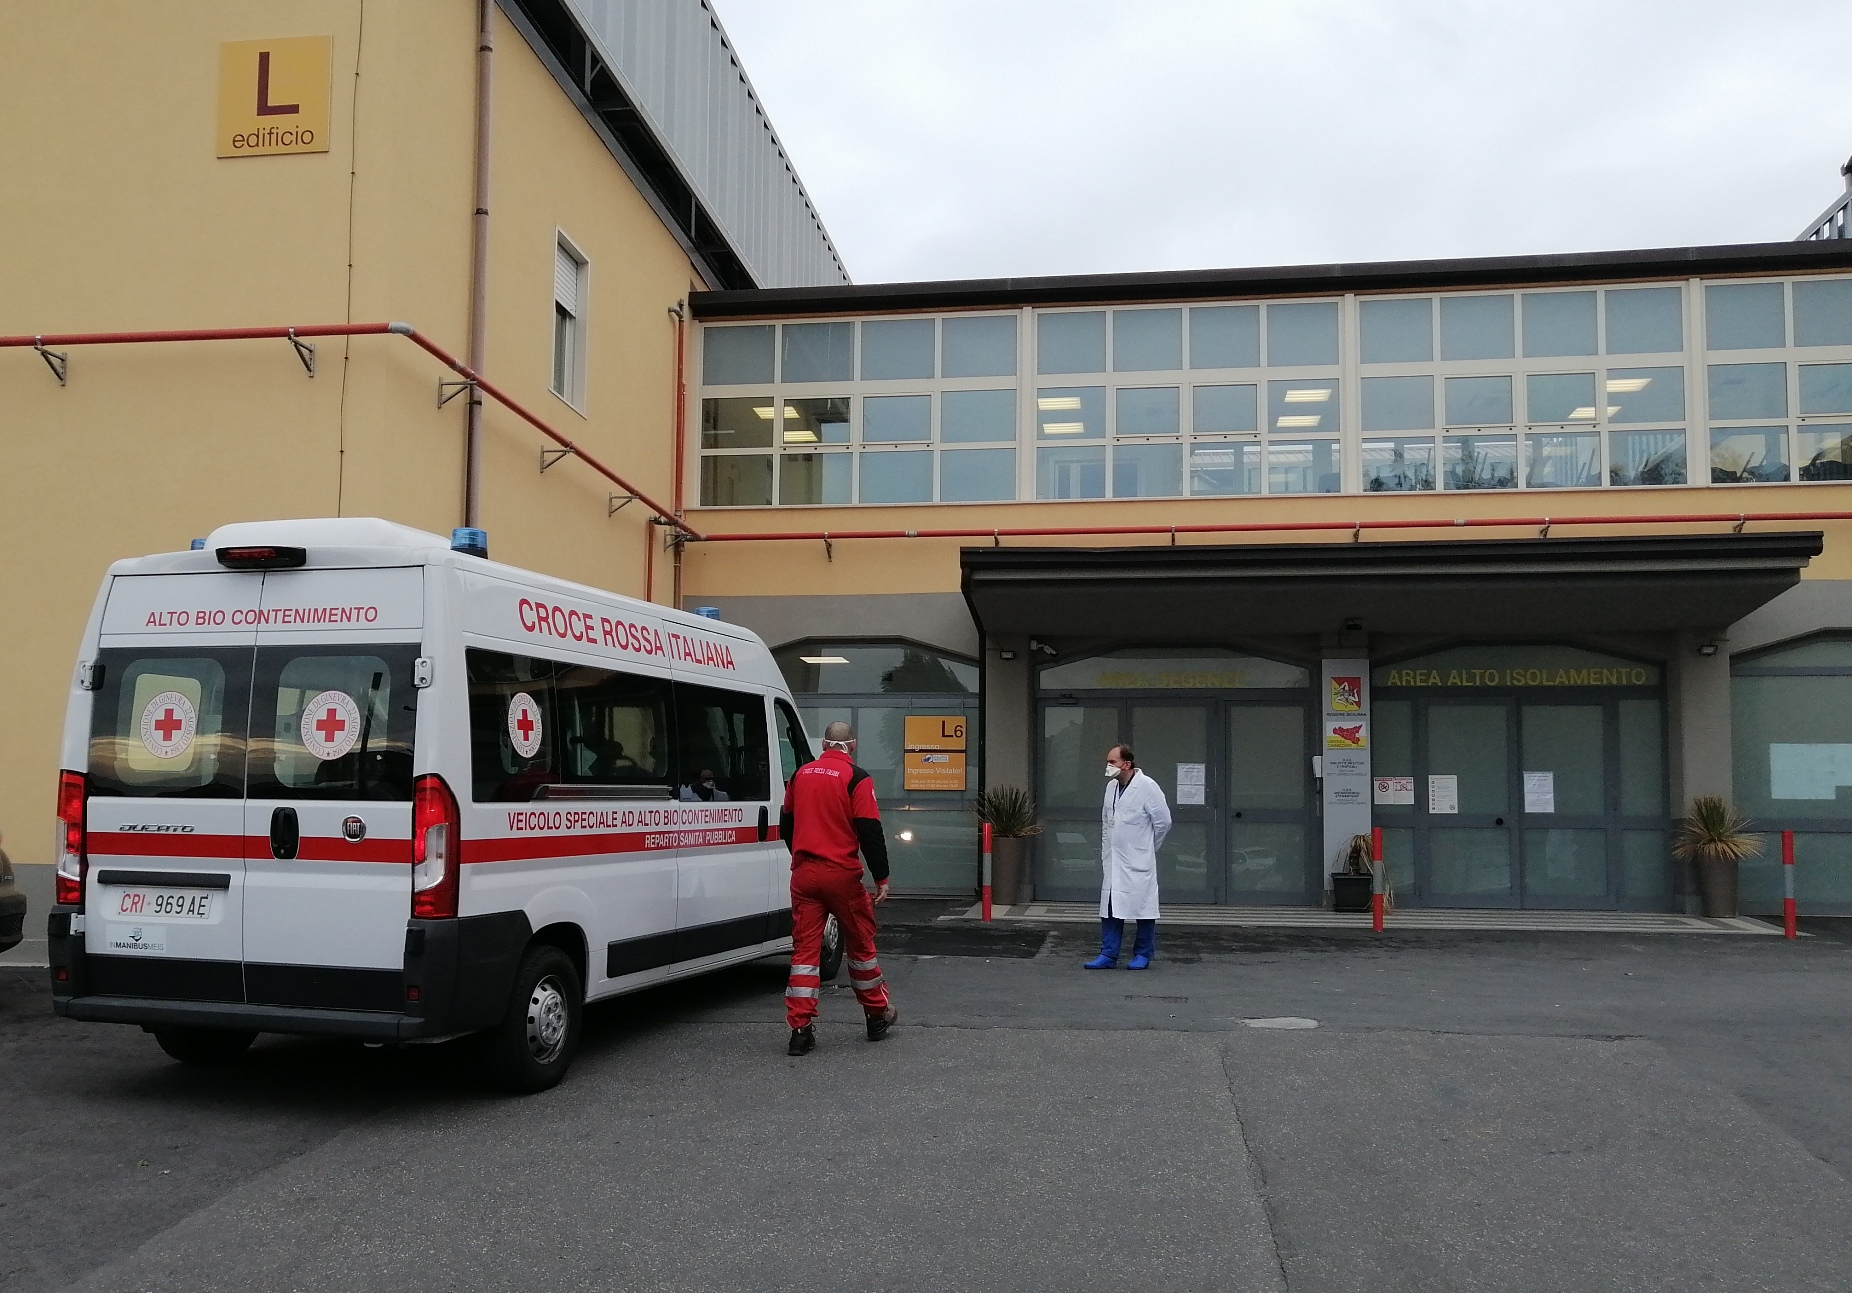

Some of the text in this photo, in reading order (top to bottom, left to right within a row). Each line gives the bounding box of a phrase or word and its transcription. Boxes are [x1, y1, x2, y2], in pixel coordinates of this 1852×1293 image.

[257, 52, 300, 116] L
[232, 125, 314, 148] edificio
[146, 606, 378, 626] ALTO BIO CONTENIMENTO
[518, 598, 736, 670] CROCE ROSSA ITALIANA
[1387, 668, 1646, 686] AREA ALTO ISOLAMENTO
[159, 694, 186, 707] GINEVRA
[182, 716, 195, 746] AGOSTO
[303, 710, 324, 757] CONVENZIONE
[321, 693, 349, 707] GINEVRA
[345, 717, 358, 746] AGOSTO
[942, 720, 964, 738] L6
[908, 743, 940, 751] ingresso
[119, 824, 195, 832] DUCATO
[347, 822, 360, 834] FIAT
[508, 808, 743, 831] VEICOLO SPECIALE AD ALTO BIO CONTENIMENTO
[645, 830, 736, 848] REPARTO SANITA' PUBBLICA
[120, 893, 146, 913] CRI
